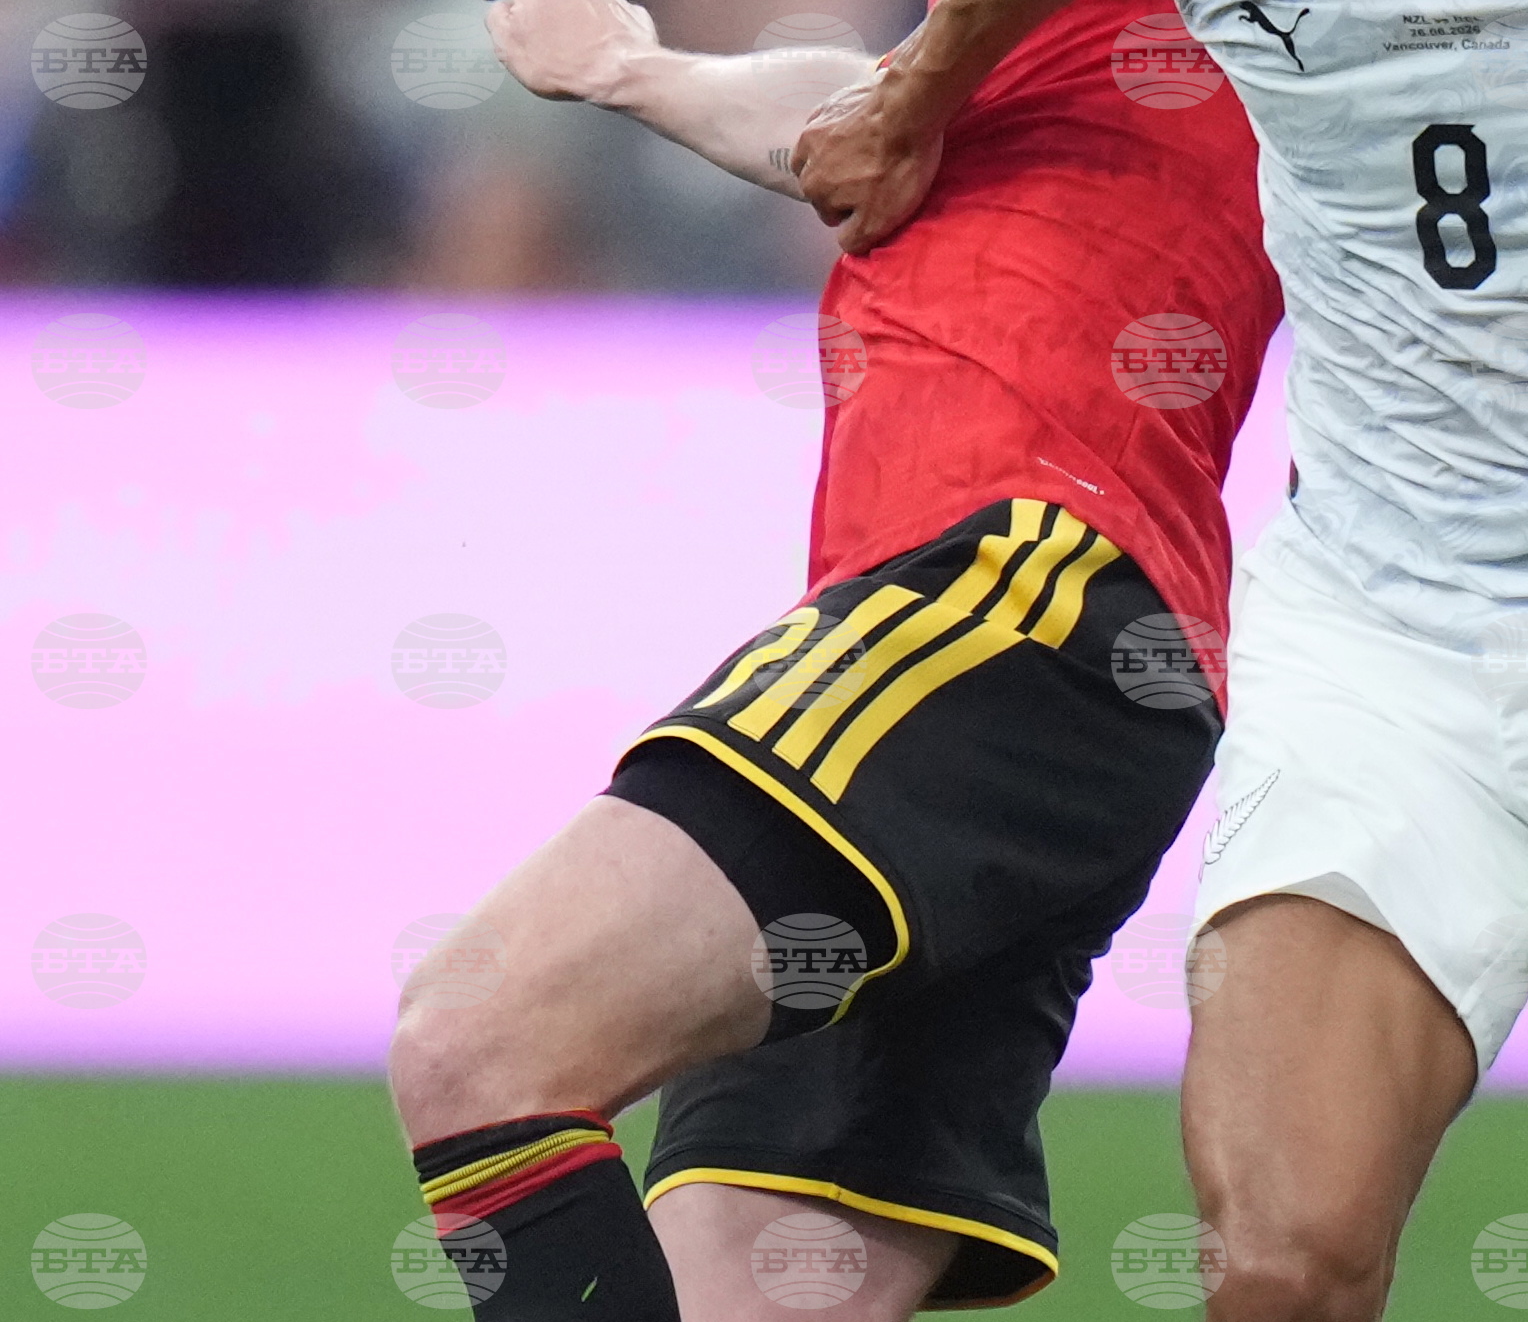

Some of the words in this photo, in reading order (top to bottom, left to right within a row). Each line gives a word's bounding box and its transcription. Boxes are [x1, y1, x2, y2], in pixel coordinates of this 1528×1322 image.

[1383, 40, 1457, 52] Vancouver,
[1461, 39, 1510, 51] Canada
[1412, 123, 1497, 290] 8
